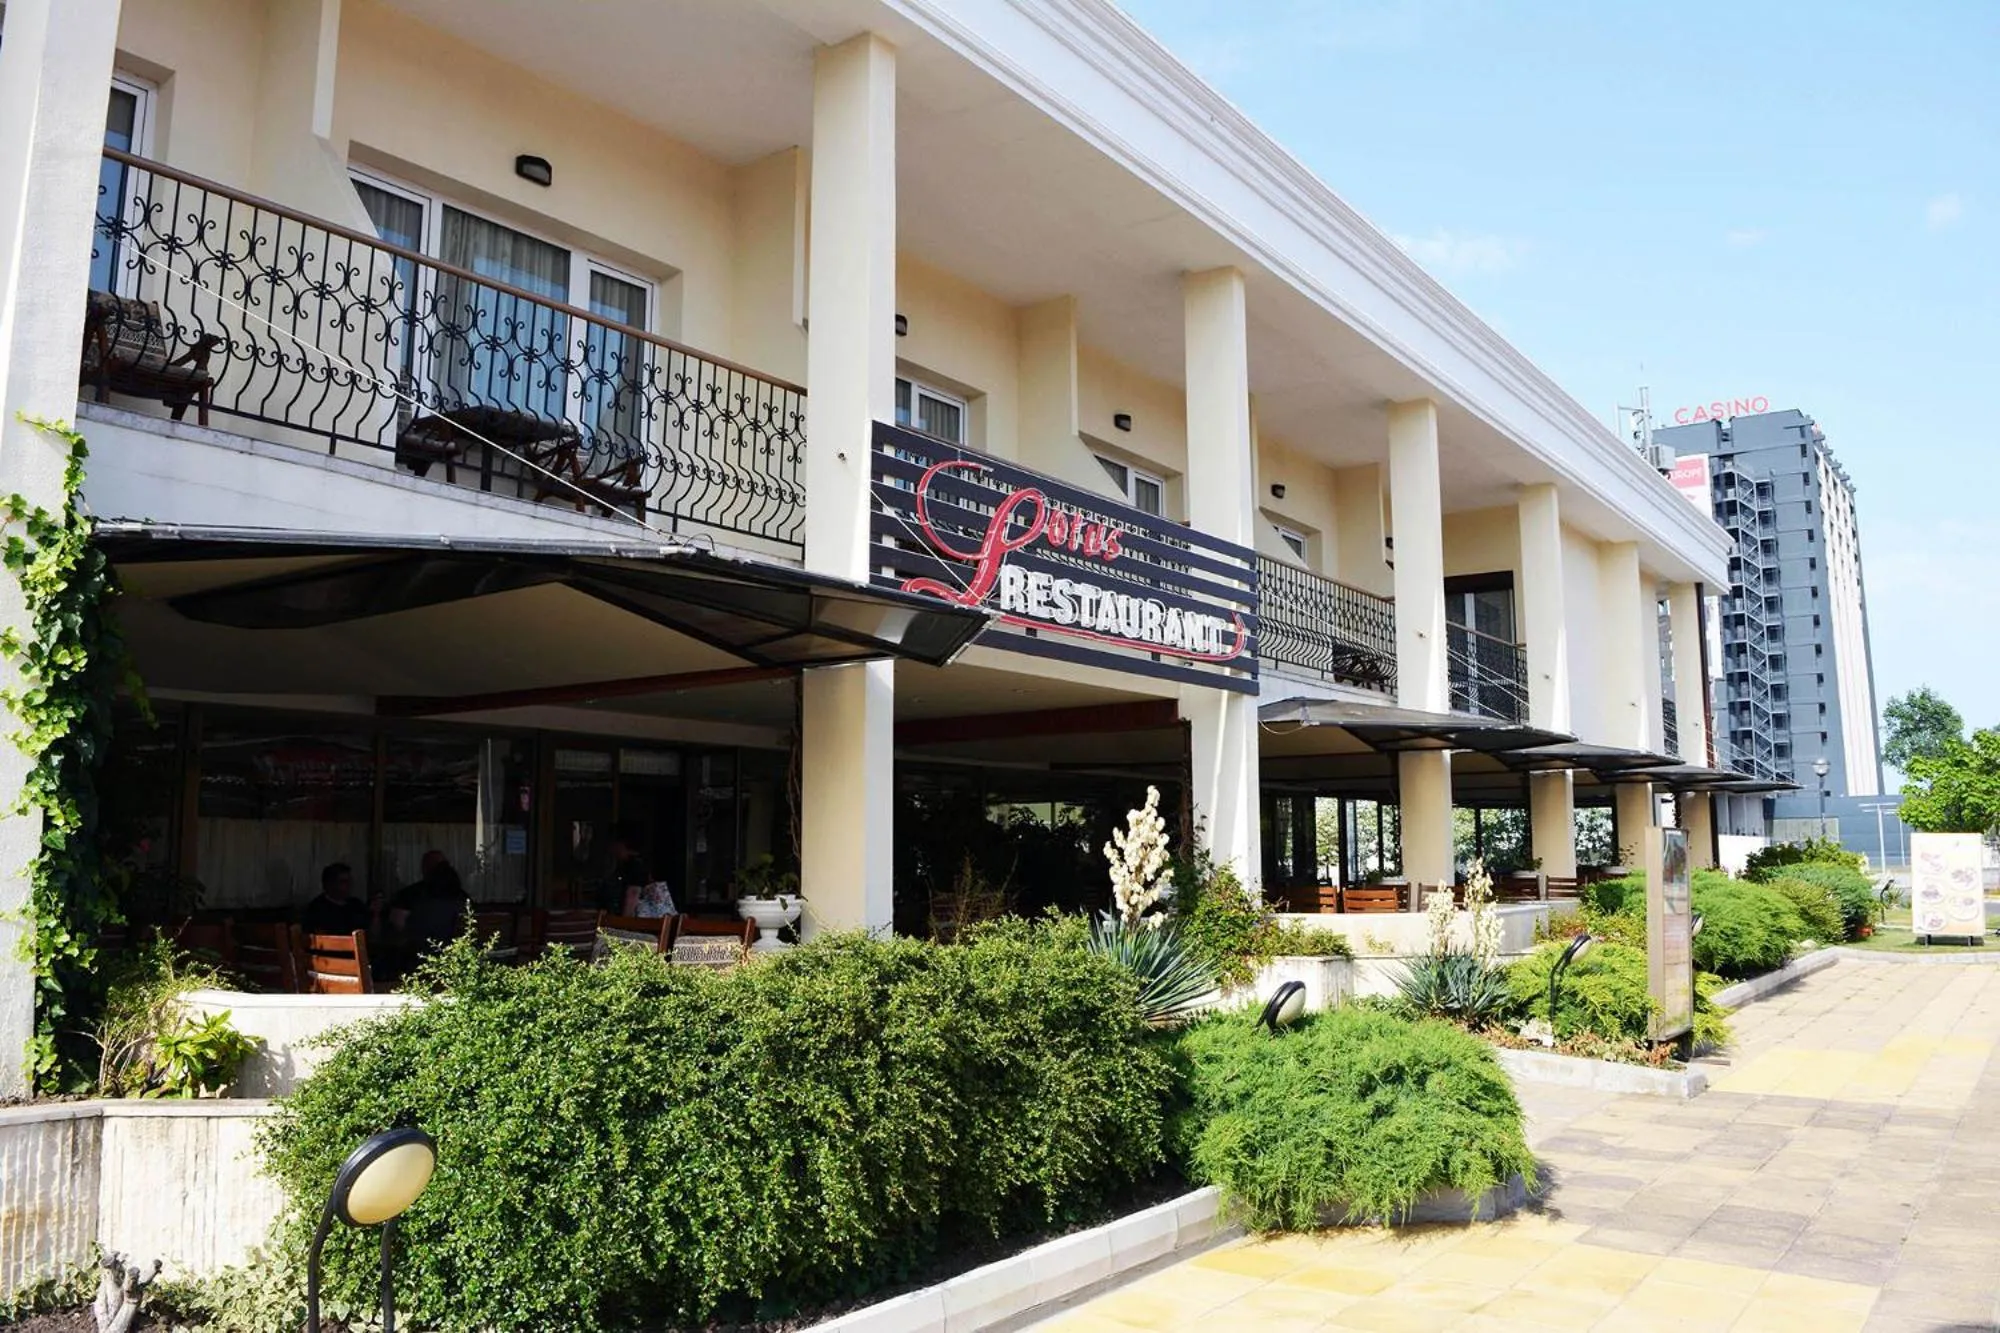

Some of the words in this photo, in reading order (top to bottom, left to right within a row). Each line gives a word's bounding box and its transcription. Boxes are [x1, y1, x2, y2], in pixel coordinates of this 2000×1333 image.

[1675, 397, 1769, 424] CASINO
[900, 460, 1122, 608] Lotus
[1001, 565, 1226, 655] RESTAURANT
